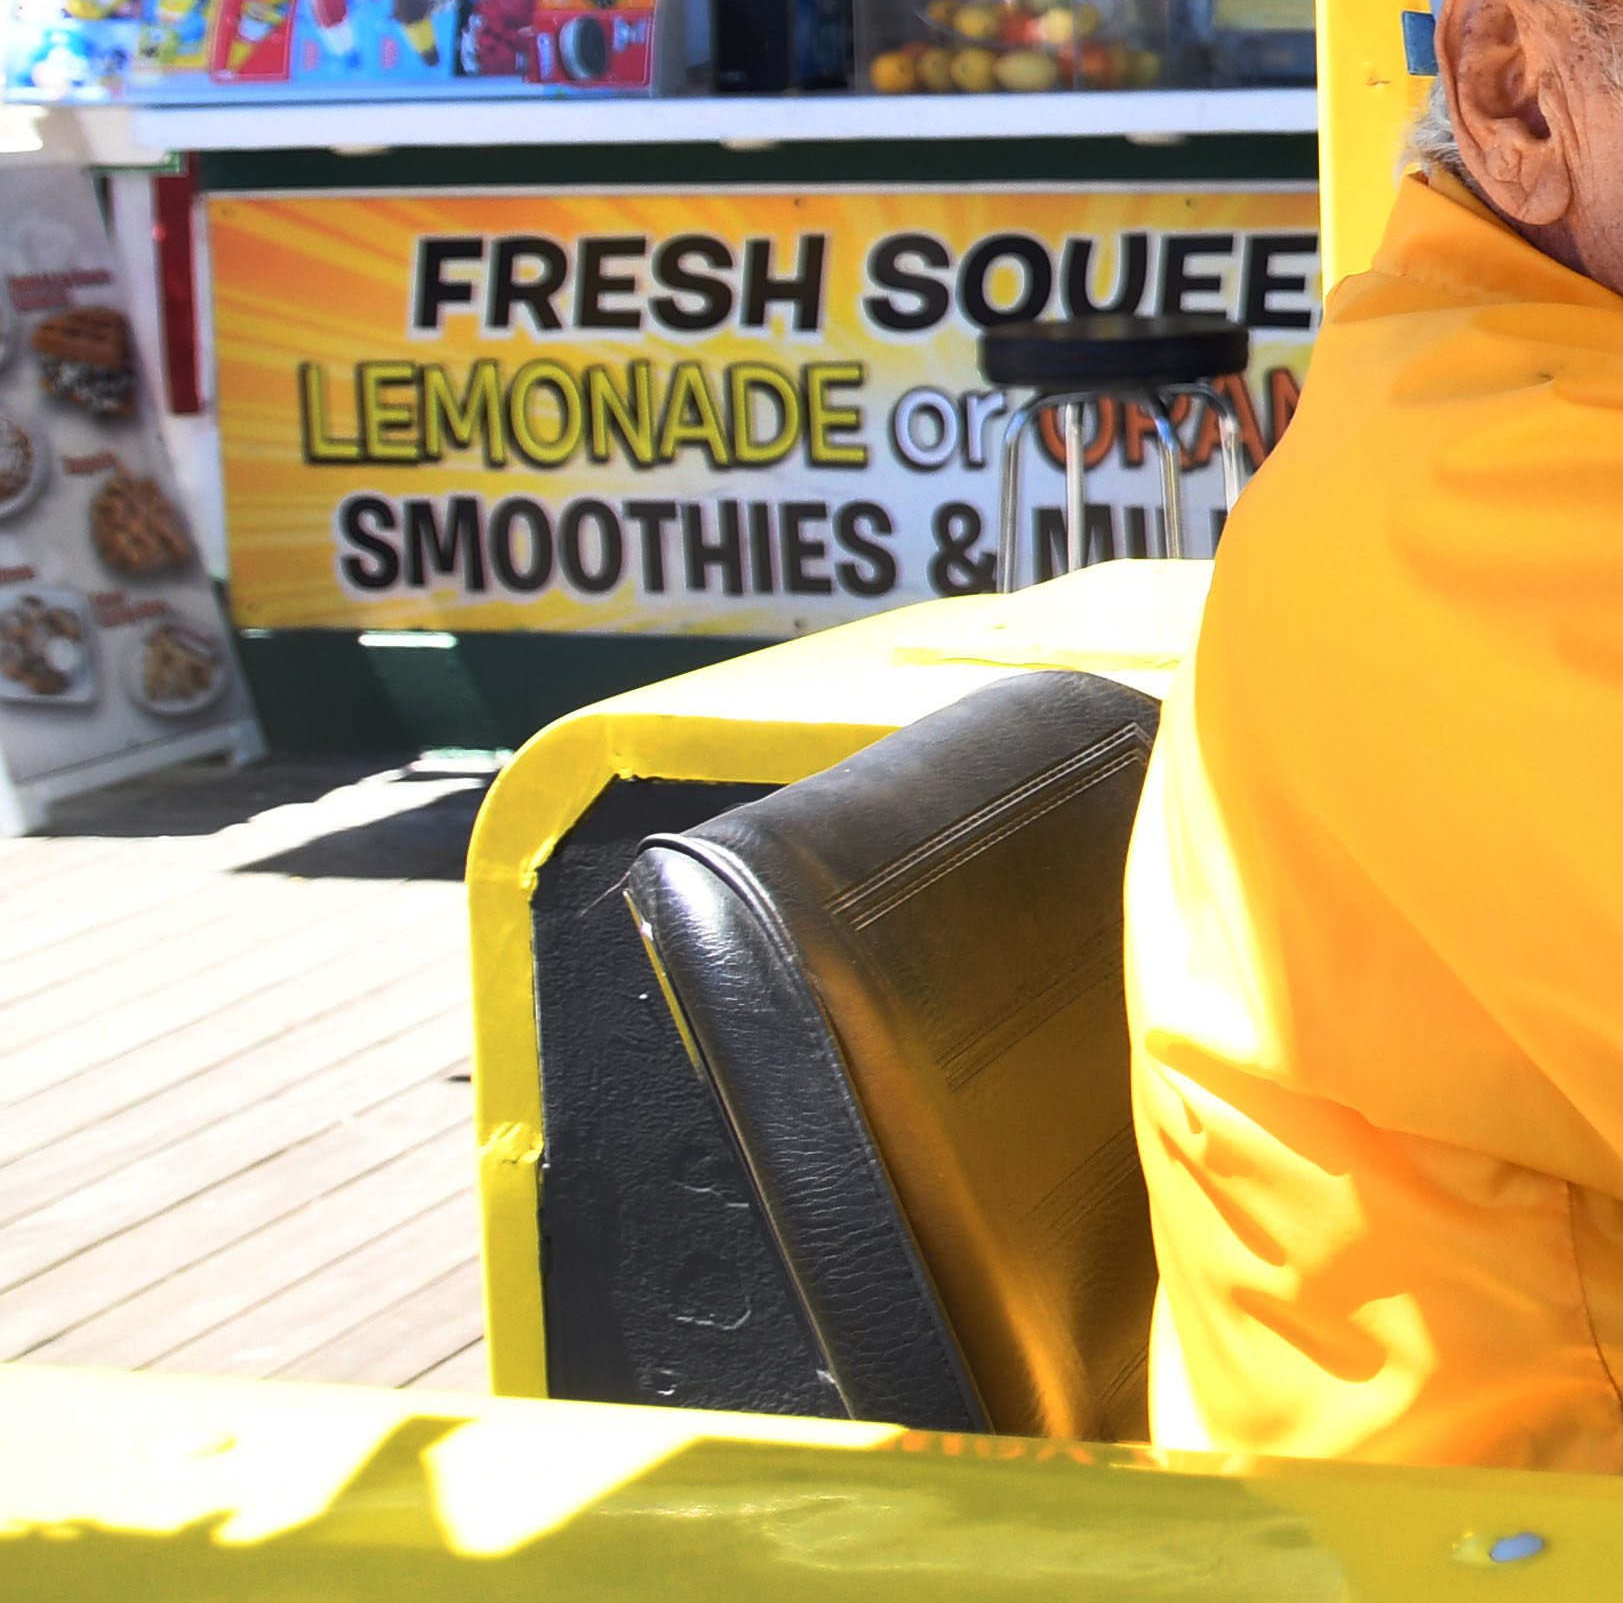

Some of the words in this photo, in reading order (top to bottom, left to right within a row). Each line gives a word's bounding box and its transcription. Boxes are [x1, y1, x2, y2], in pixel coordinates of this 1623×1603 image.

[410, 232, 828, 333] FRESH
[300, 358, 870, 468] LEMONADE
[893, 384, 1007, 471] or
[338, 494, 898, 597] SMOOTHIES
[928, 501, 998, 596] &
